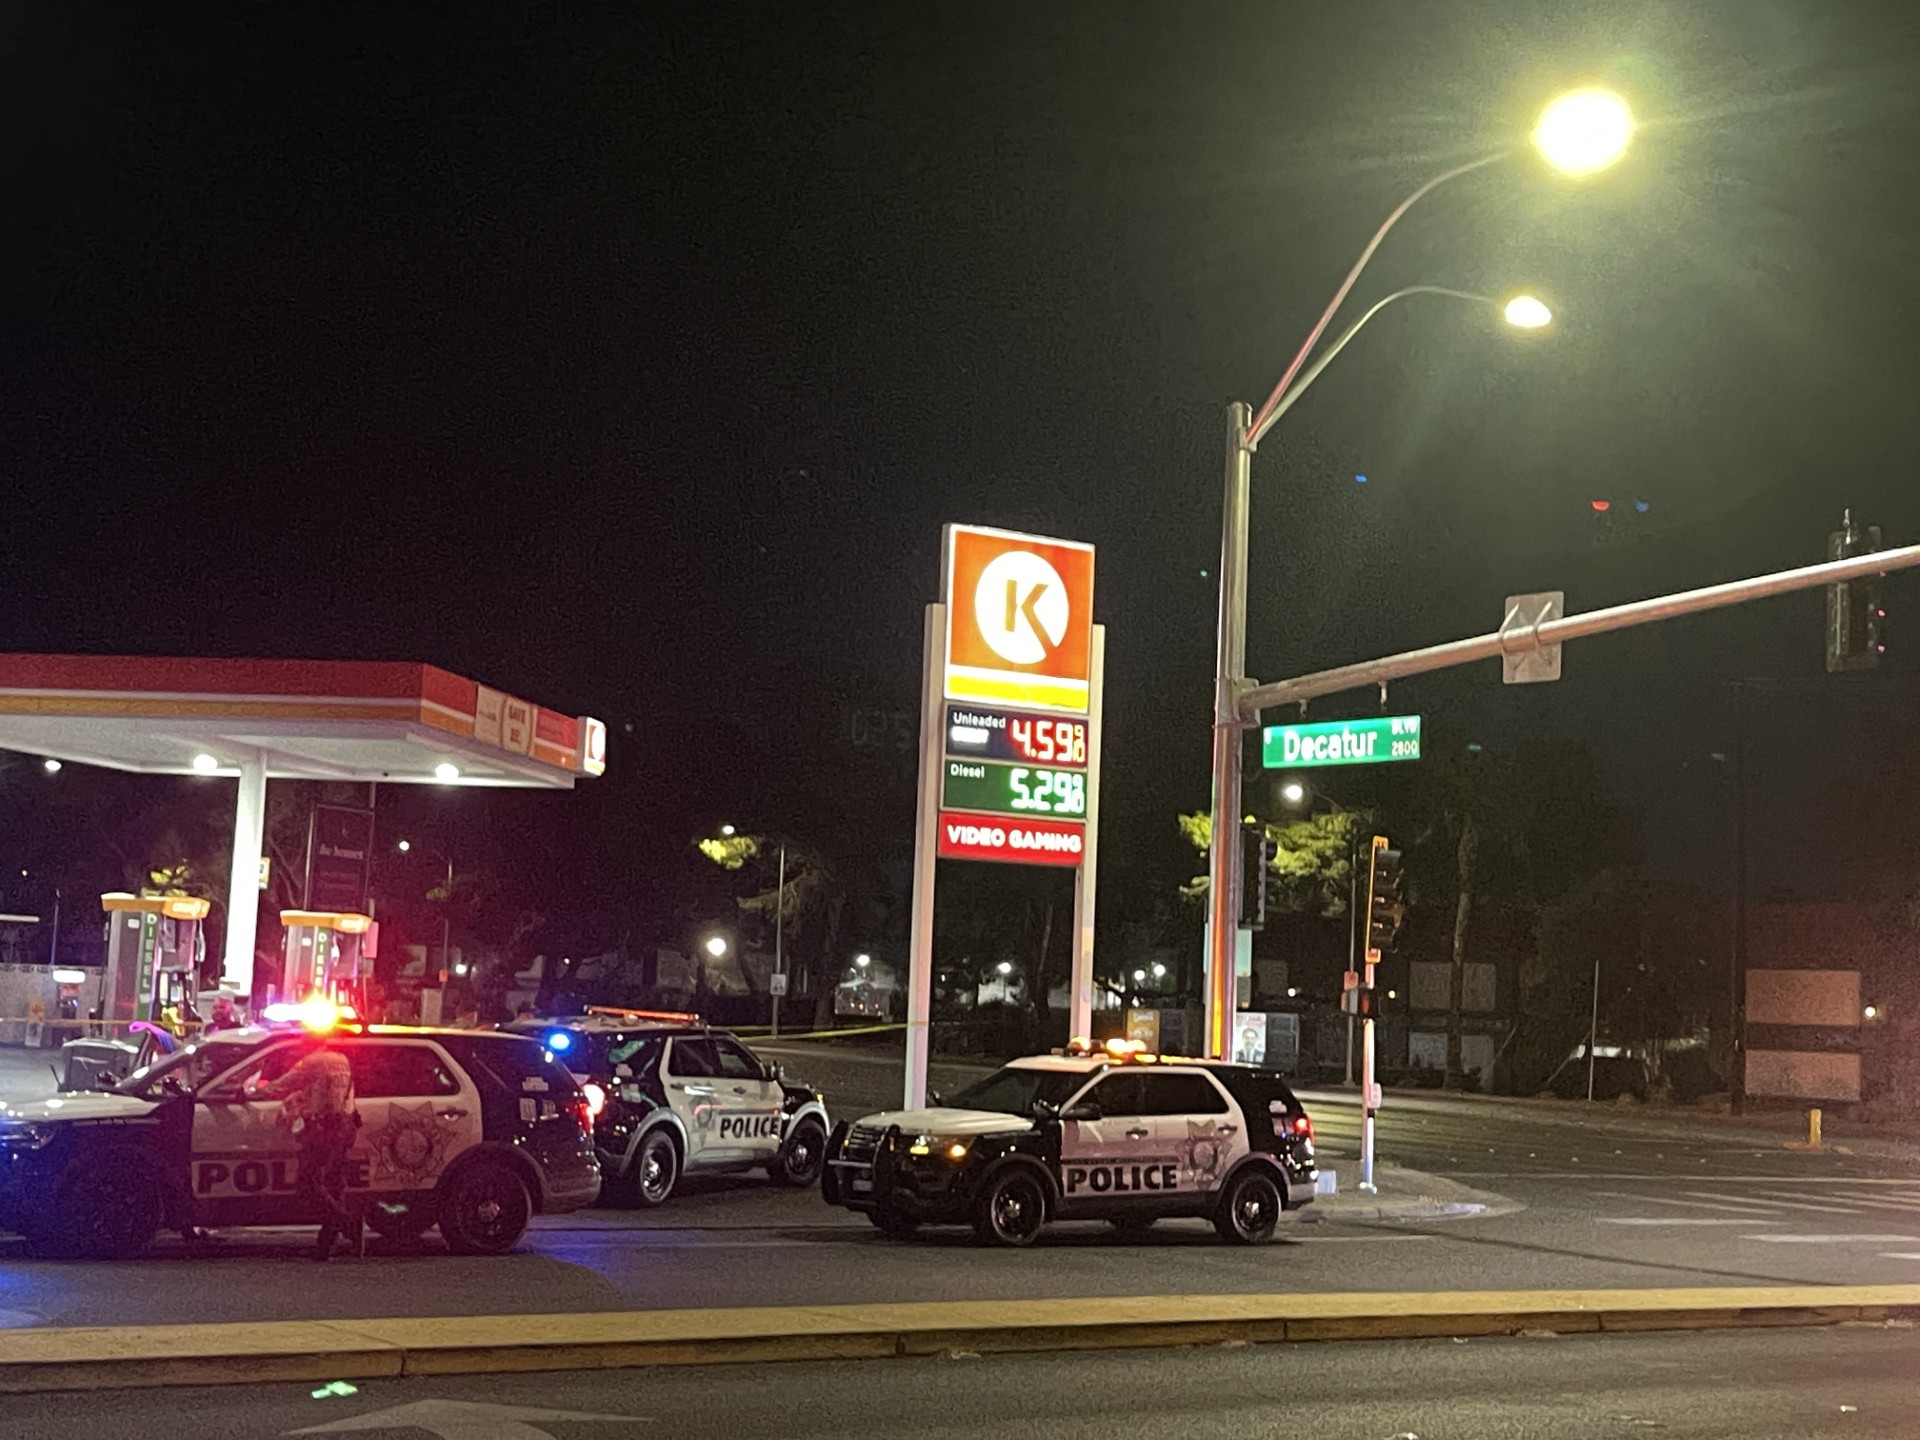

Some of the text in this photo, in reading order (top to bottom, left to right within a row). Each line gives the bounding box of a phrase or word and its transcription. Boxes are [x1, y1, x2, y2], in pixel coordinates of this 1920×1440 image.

[1006, 579, 1058, 652] K
[953, 712, 1006, 729] Unleaded
[1283, 726, 1378, 762] Decatur
[1391, 740, 1418, 757] 2800
[950, 763, 985, 779] Diesel
[947, 825, 1082, 853] VIDEO GAMING
[142, 913, 158, 988] DIESEL
[720, 1117, 780, 1139] POLICE
[197, 1158, 370, 1194] POLE
[1066, 1165, 1178, 1193] POLICE
